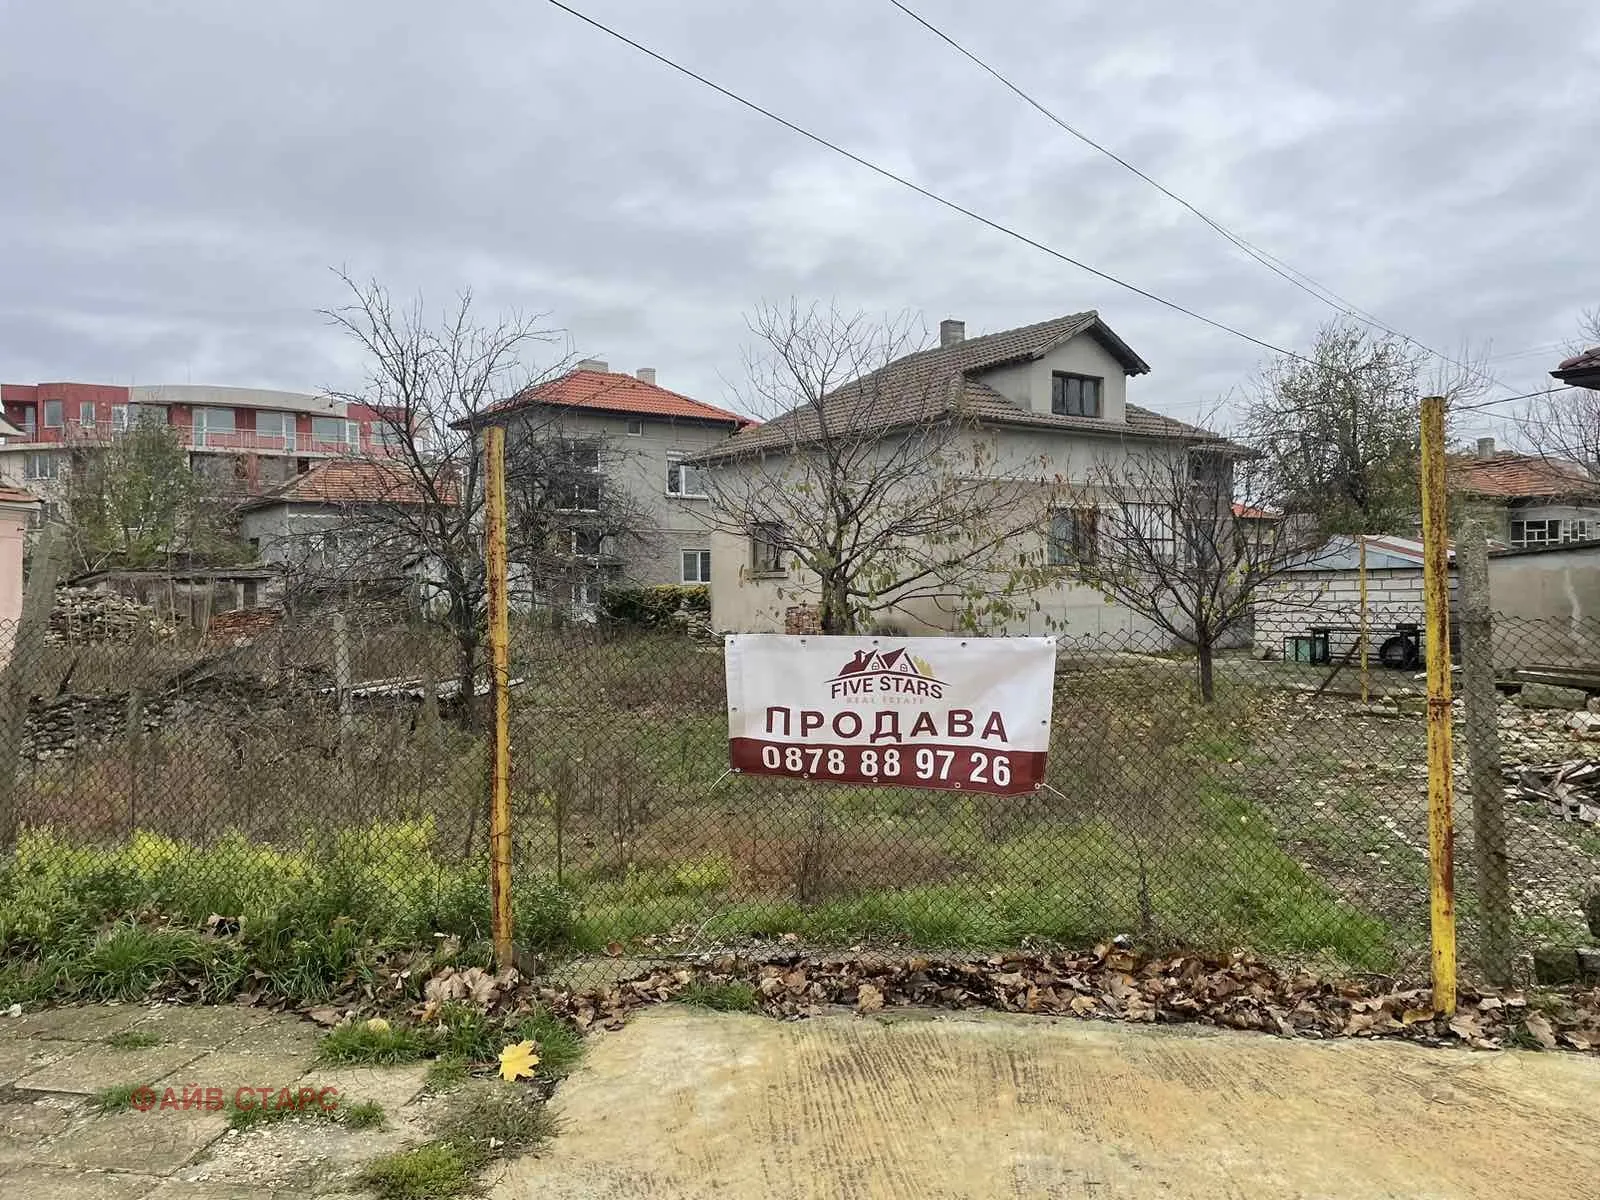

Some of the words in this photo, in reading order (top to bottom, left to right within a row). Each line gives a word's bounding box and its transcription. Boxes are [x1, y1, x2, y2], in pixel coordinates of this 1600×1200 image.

[831, 678, 873, 699] FIVE
[880, 676, 942, 699] STARS
[766, 706, 1009, 744] ПРОДАВА
[762, 745, 845, 775] 0878
[860, 749, 901, 777] 88
[915, 748, 955, 780] 97
[969, 752, 1011, 786] 26
